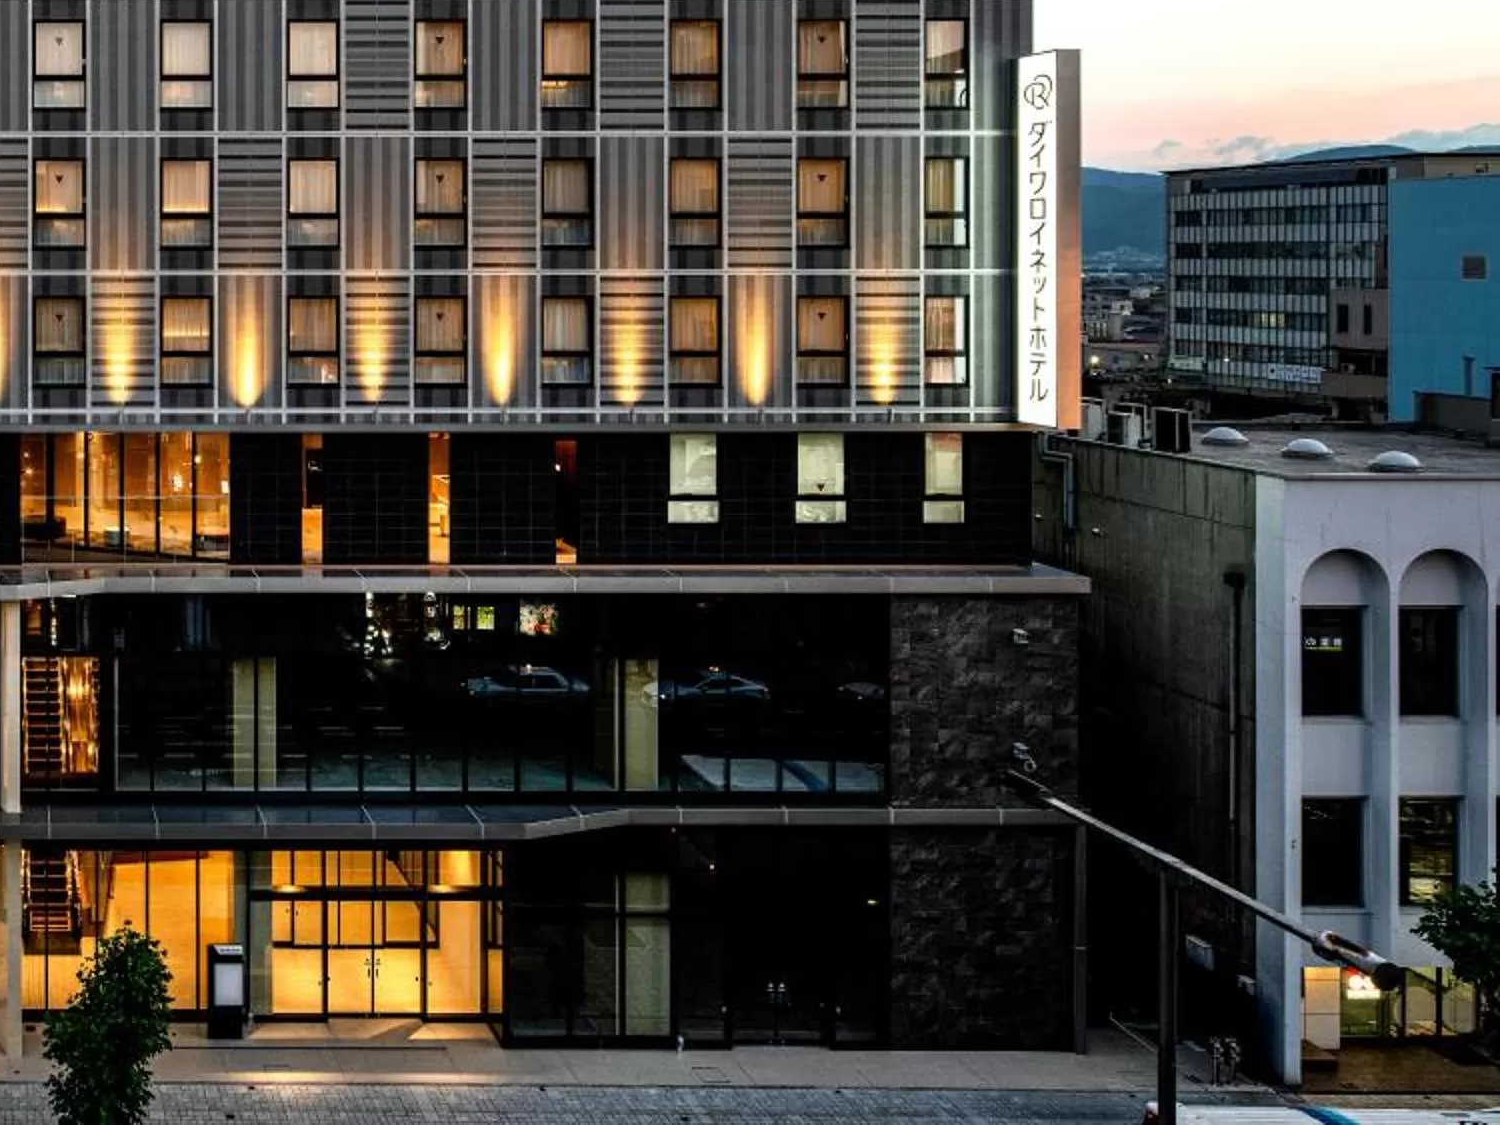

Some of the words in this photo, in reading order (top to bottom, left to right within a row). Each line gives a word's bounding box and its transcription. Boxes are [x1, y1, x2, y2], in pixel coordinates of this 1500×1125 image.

[1029, 120, 1052, 402] ダイワロイネットホテル
